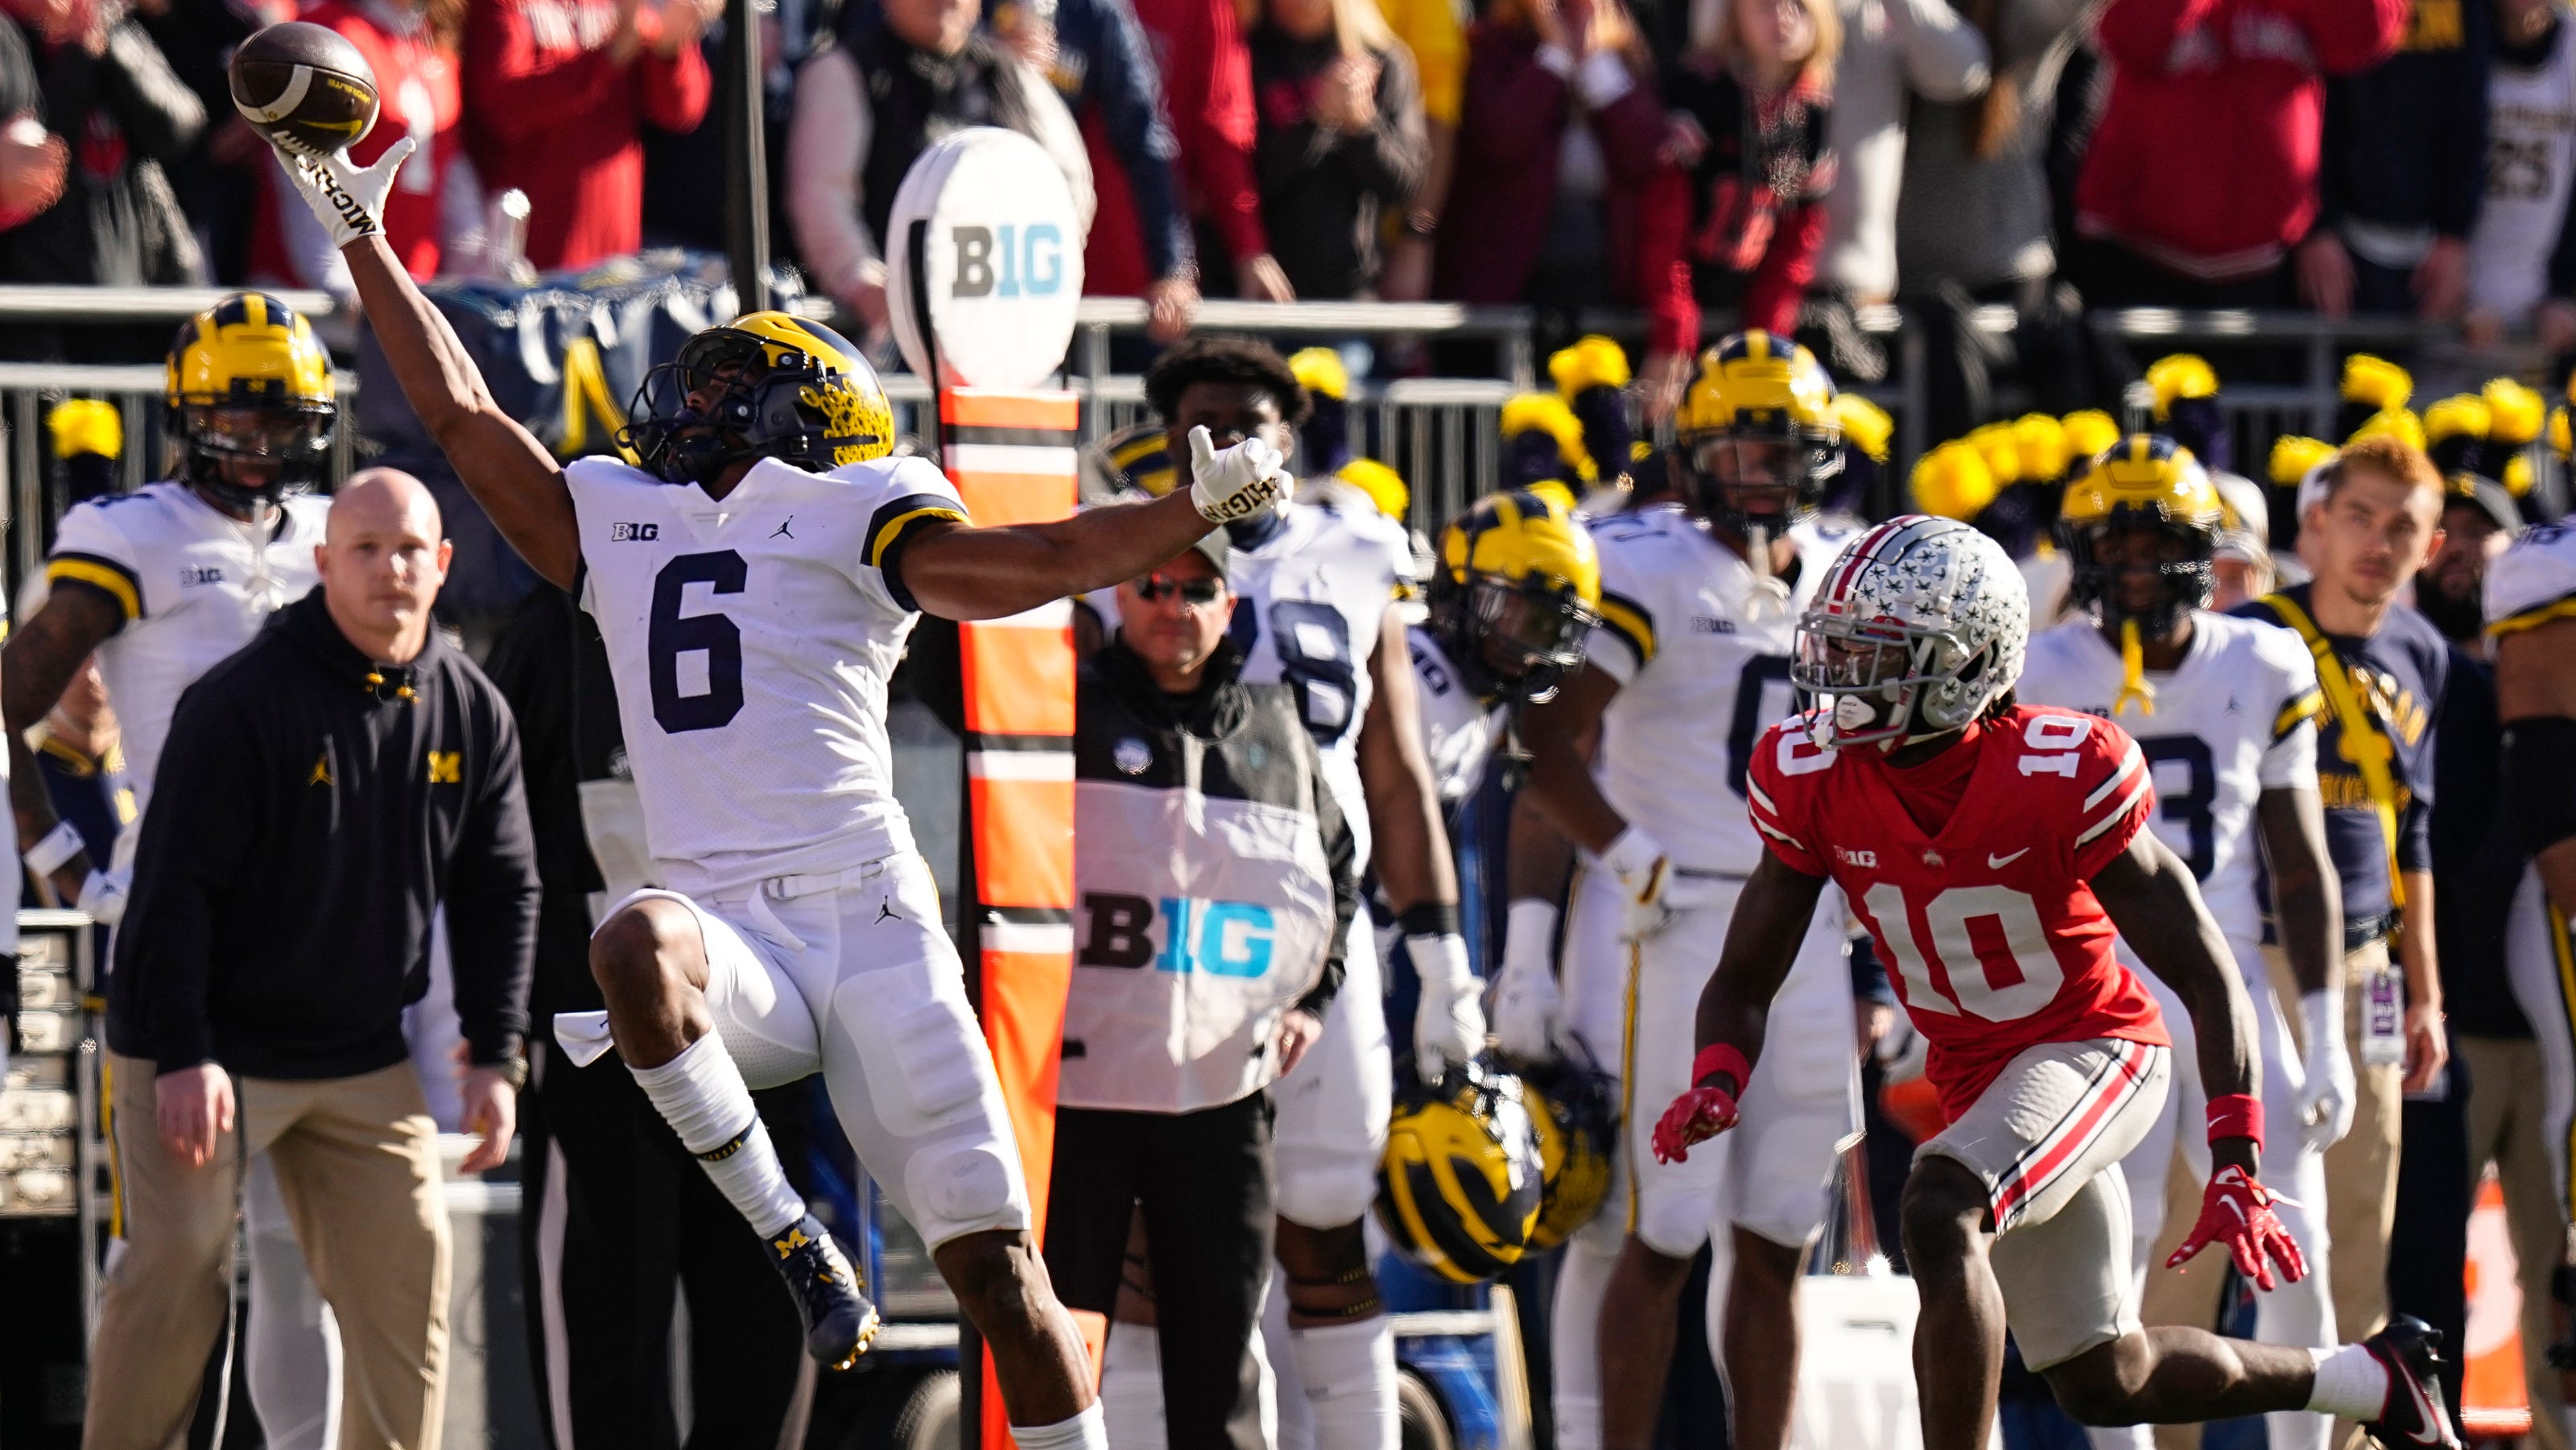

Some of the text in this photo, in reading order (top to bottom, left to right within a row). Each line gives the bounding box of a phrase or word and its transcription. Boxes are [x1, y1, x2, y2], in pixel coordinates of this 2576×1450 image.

[648, 548, 749, 735] 6
[427, 750, 460, 783] M
[2018, 714, 2093, 779] 10
[1863, 882, 2066, 1022] 10
[774, 1228, 811, 1260] M
